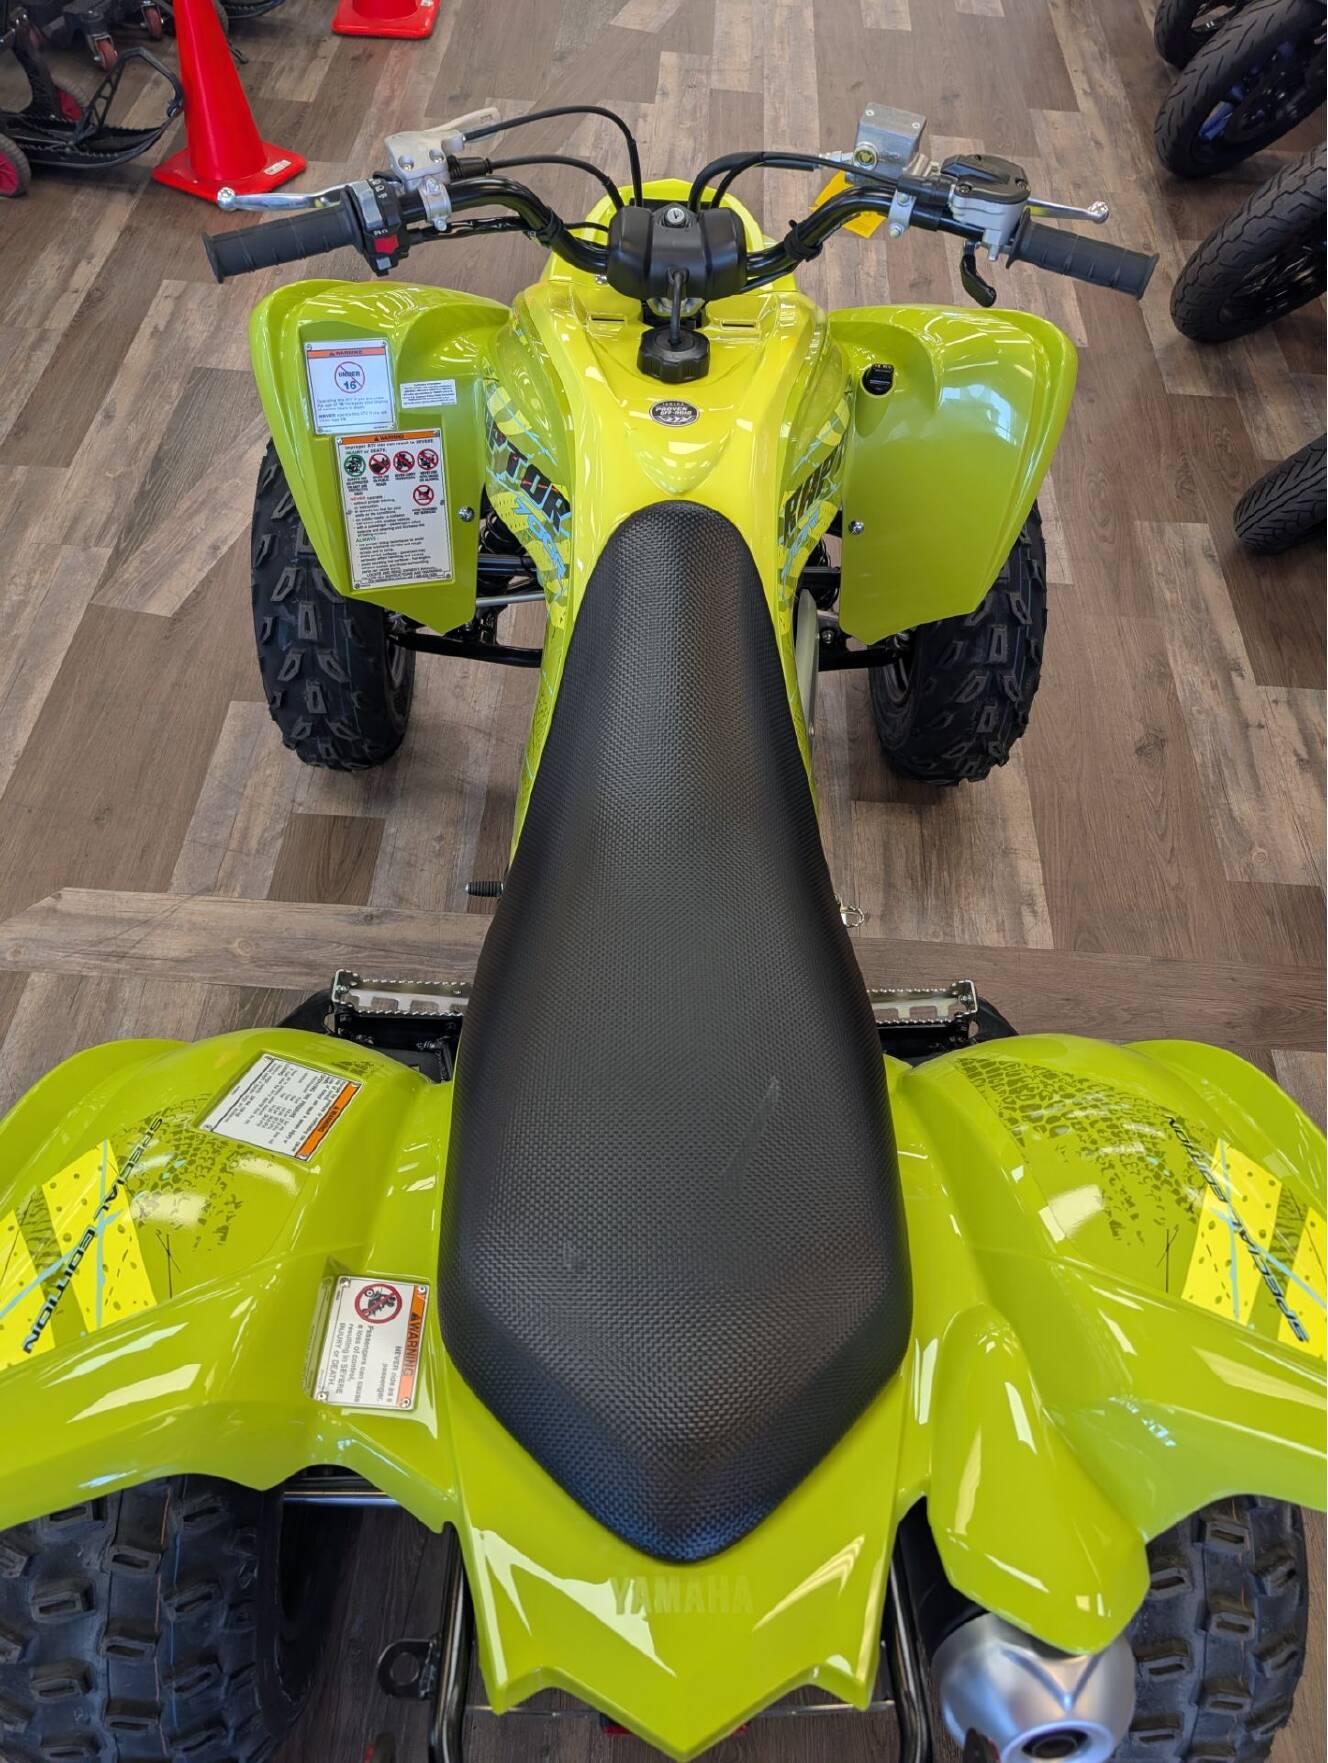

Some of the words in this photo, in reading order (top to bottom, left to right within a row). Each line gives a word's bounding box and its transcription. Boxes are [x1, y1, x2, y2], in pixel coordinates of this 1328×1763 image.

[343, 381, 357, 390] 16
[23, 1224, 97, 1354] EDITION
[403, 1322, 422, 1376] WARNING
[609, 1576, 754, 1616] YAMAHA
